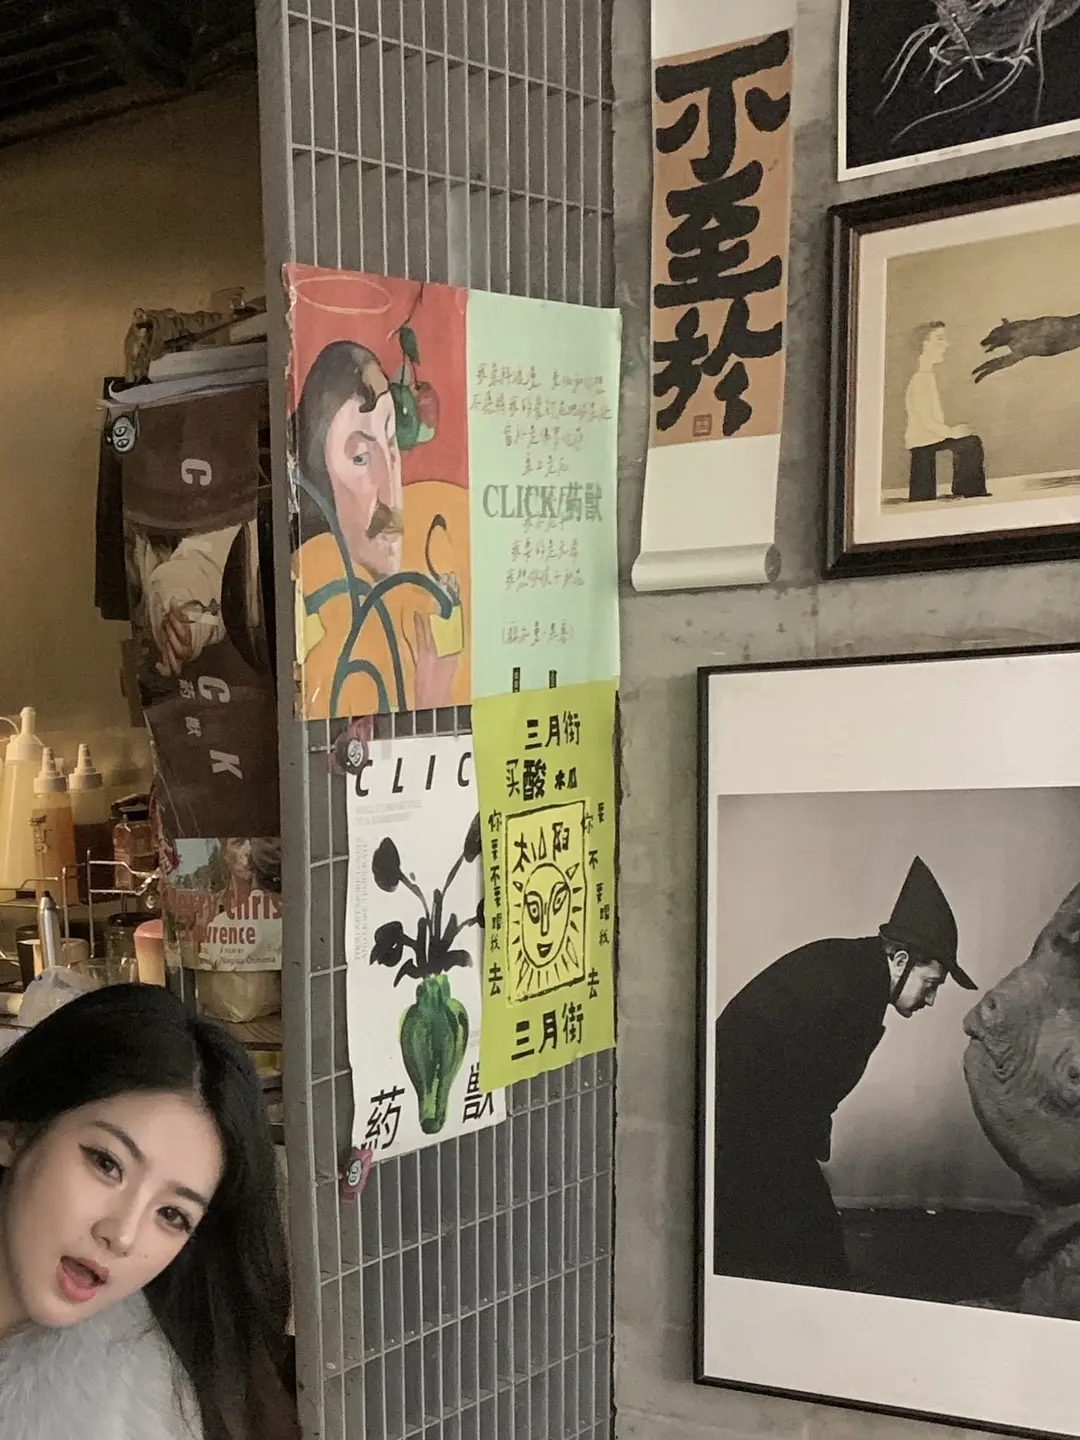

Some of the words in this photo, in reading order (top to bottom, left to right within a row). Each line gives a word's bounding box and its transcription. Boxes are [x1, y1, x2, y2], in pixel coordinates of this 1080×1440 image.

[524, 711, 581, 750] 三月街
[511, 1001, 584, 1061] 三月街
